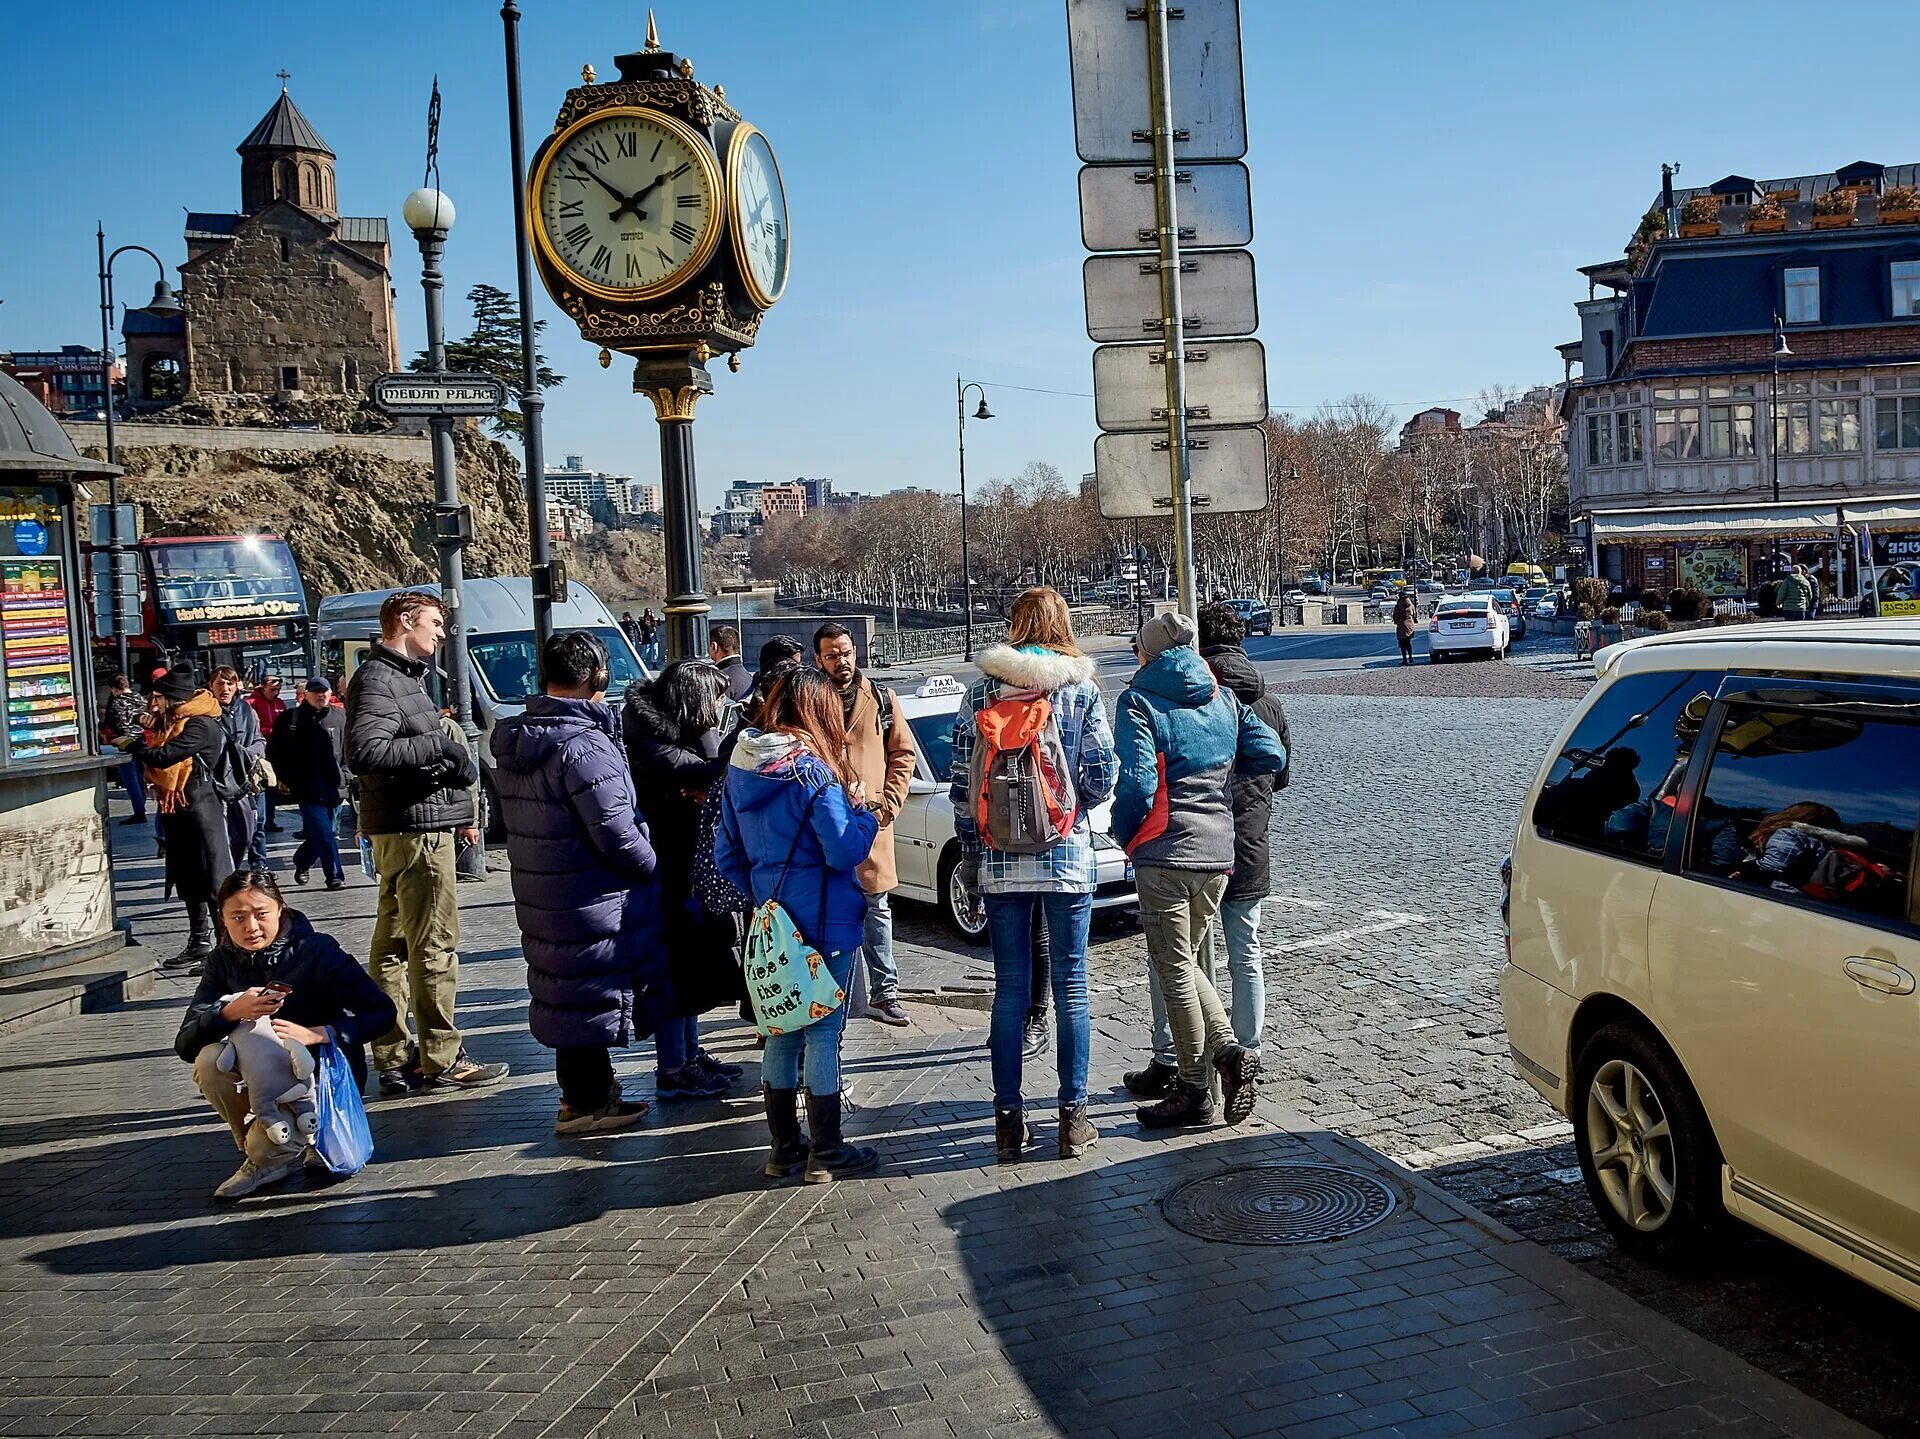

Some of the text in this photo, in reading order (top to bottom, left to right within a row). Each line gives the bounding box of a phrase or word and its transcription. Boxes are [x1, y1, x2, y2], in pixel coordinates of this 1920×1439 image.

[384, 389, 497, 400] MEIDAN PALACE
[176, 601, 300, 620] World Sightseeing Tour
[208, 624, 279, 644] RED LINE
[933, 679, 953, 687] TAXI
[757, 983, 782, 1001] the
[760, 990, 802, 1020] food?
